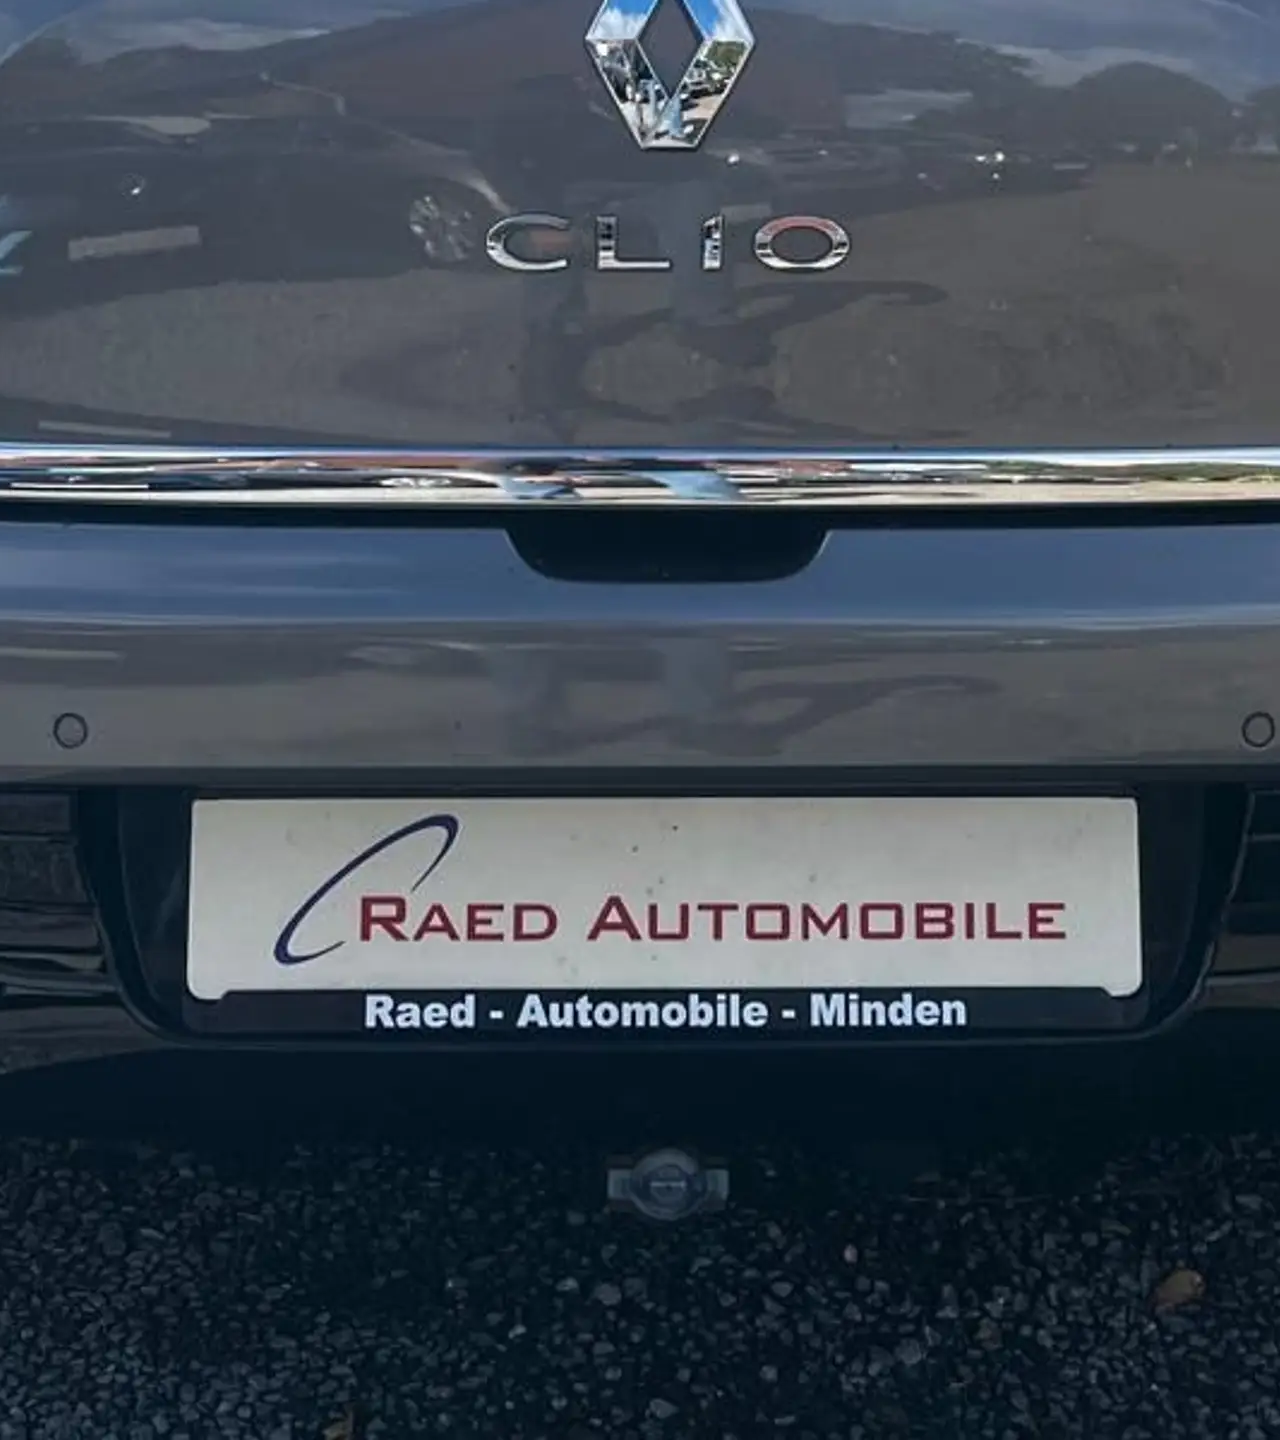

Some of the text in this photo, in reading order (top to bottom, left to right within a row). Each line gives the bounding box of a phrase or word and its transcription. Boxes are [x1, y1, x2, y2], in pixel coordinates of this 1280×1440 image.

[485, 213, 852, 271] CLIO
[359, 895, 1066, 941] RAED AUTOMOBILE
[365, 994, 475, 1027] Raed
[517, 993, 768, 1027] Automobile
[810, 993, 967, 1027] Minden
